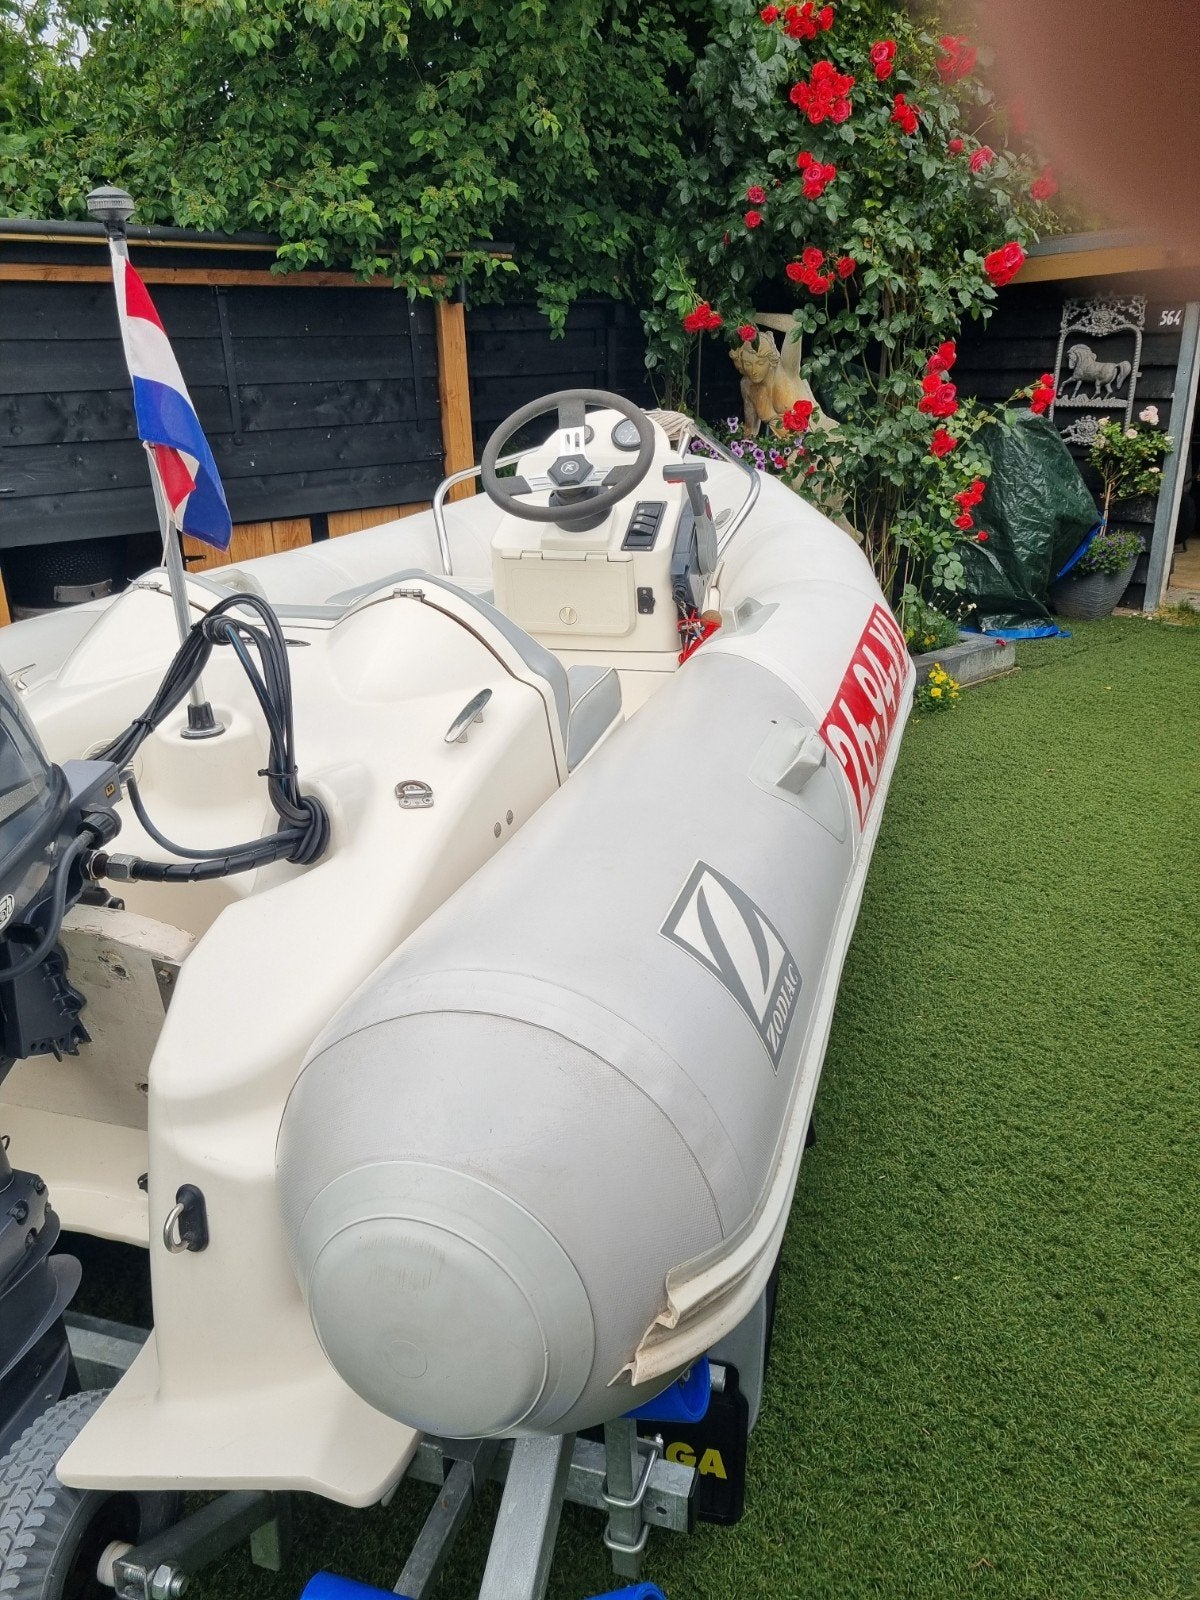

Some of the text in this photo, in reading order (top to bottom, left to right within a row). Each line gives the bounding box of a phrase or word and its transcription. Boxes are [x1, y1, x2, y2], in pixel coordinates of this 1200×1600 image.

[1159, 309, 1183, 326] 564
[766, 963, 798, 1054] ZODIAC
[644, 1436, 728, 1480] GA
